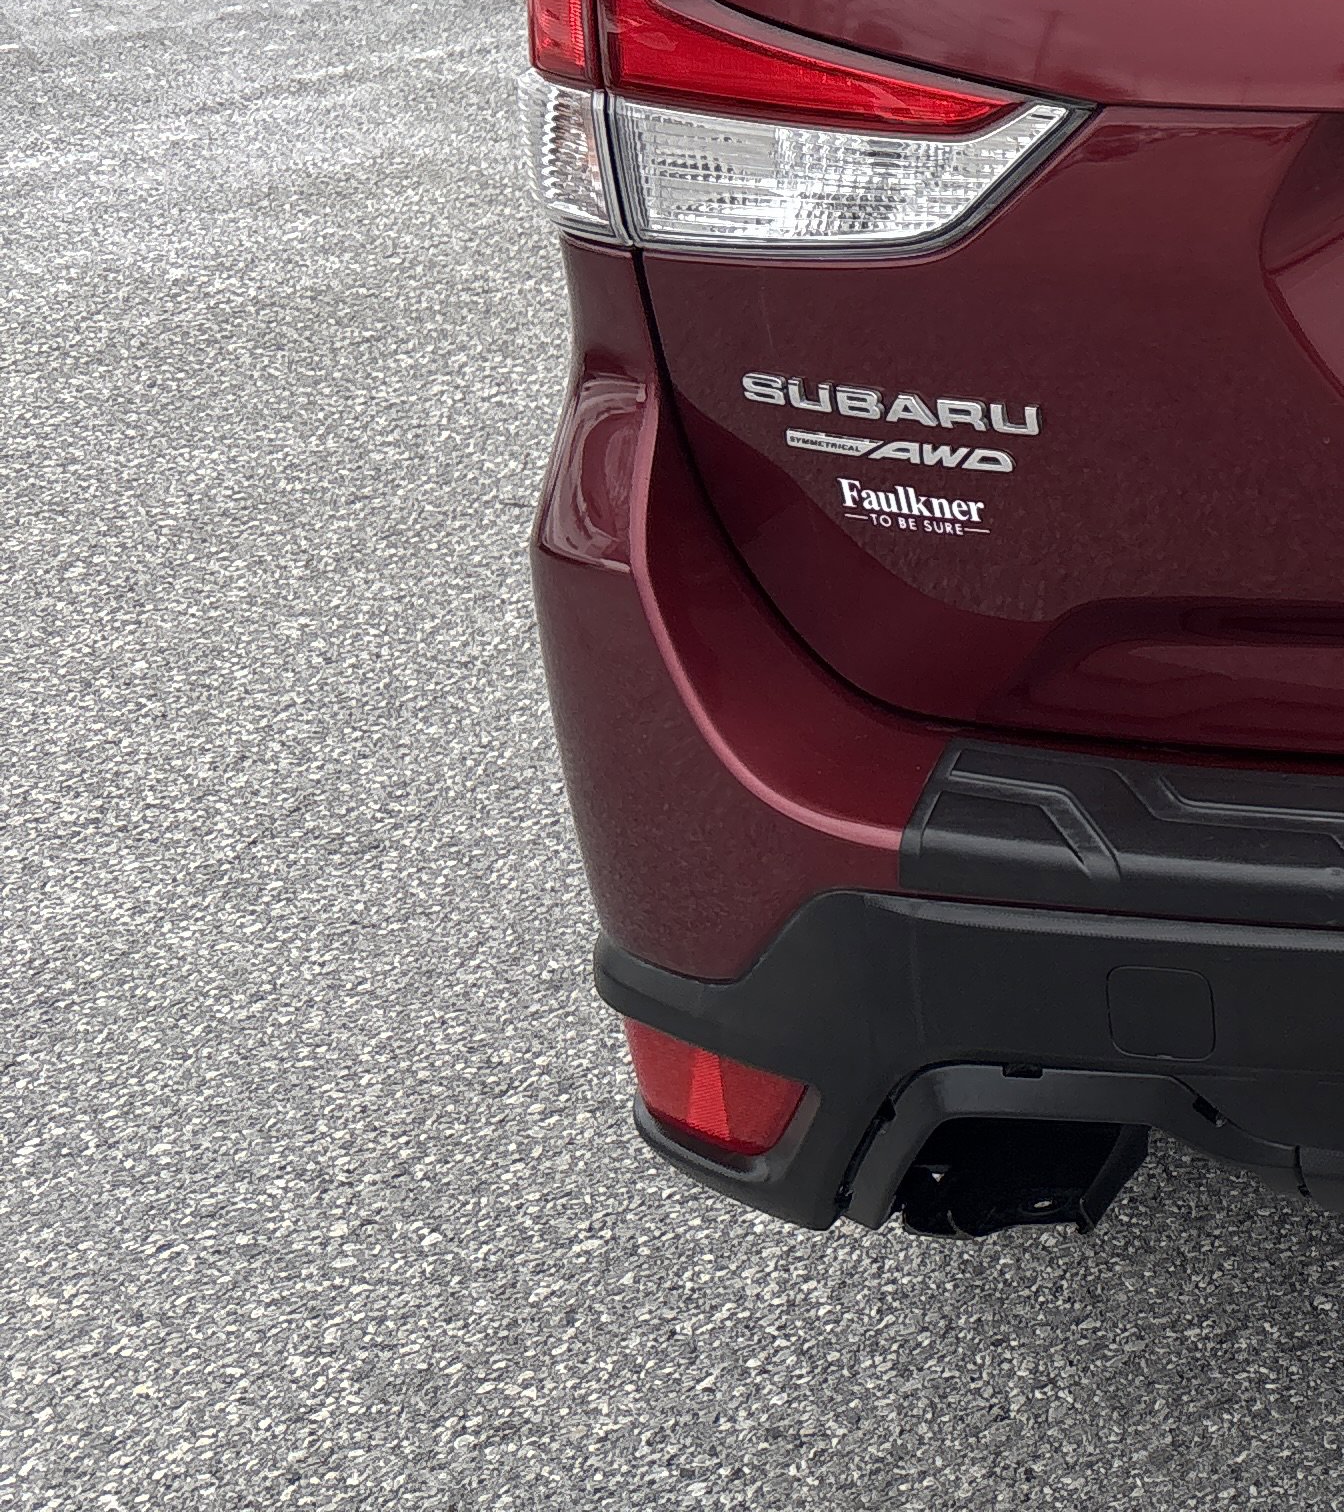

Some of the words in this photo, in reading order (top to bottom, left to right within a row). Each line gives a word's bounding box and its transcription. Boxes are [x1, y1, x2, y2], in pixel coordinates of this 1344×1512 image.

[742, 372, 1042, 436] SUBARU
[789, 435, 862, 453] SYMMETRICAL
[868, 441, 1015, 473] AWD
[837, 477, 985, 522] Faulkner
[869, 513, 892, 528] TO
[898, 517, 917, 531] BE
[924, 520, 964, 536] SURE
